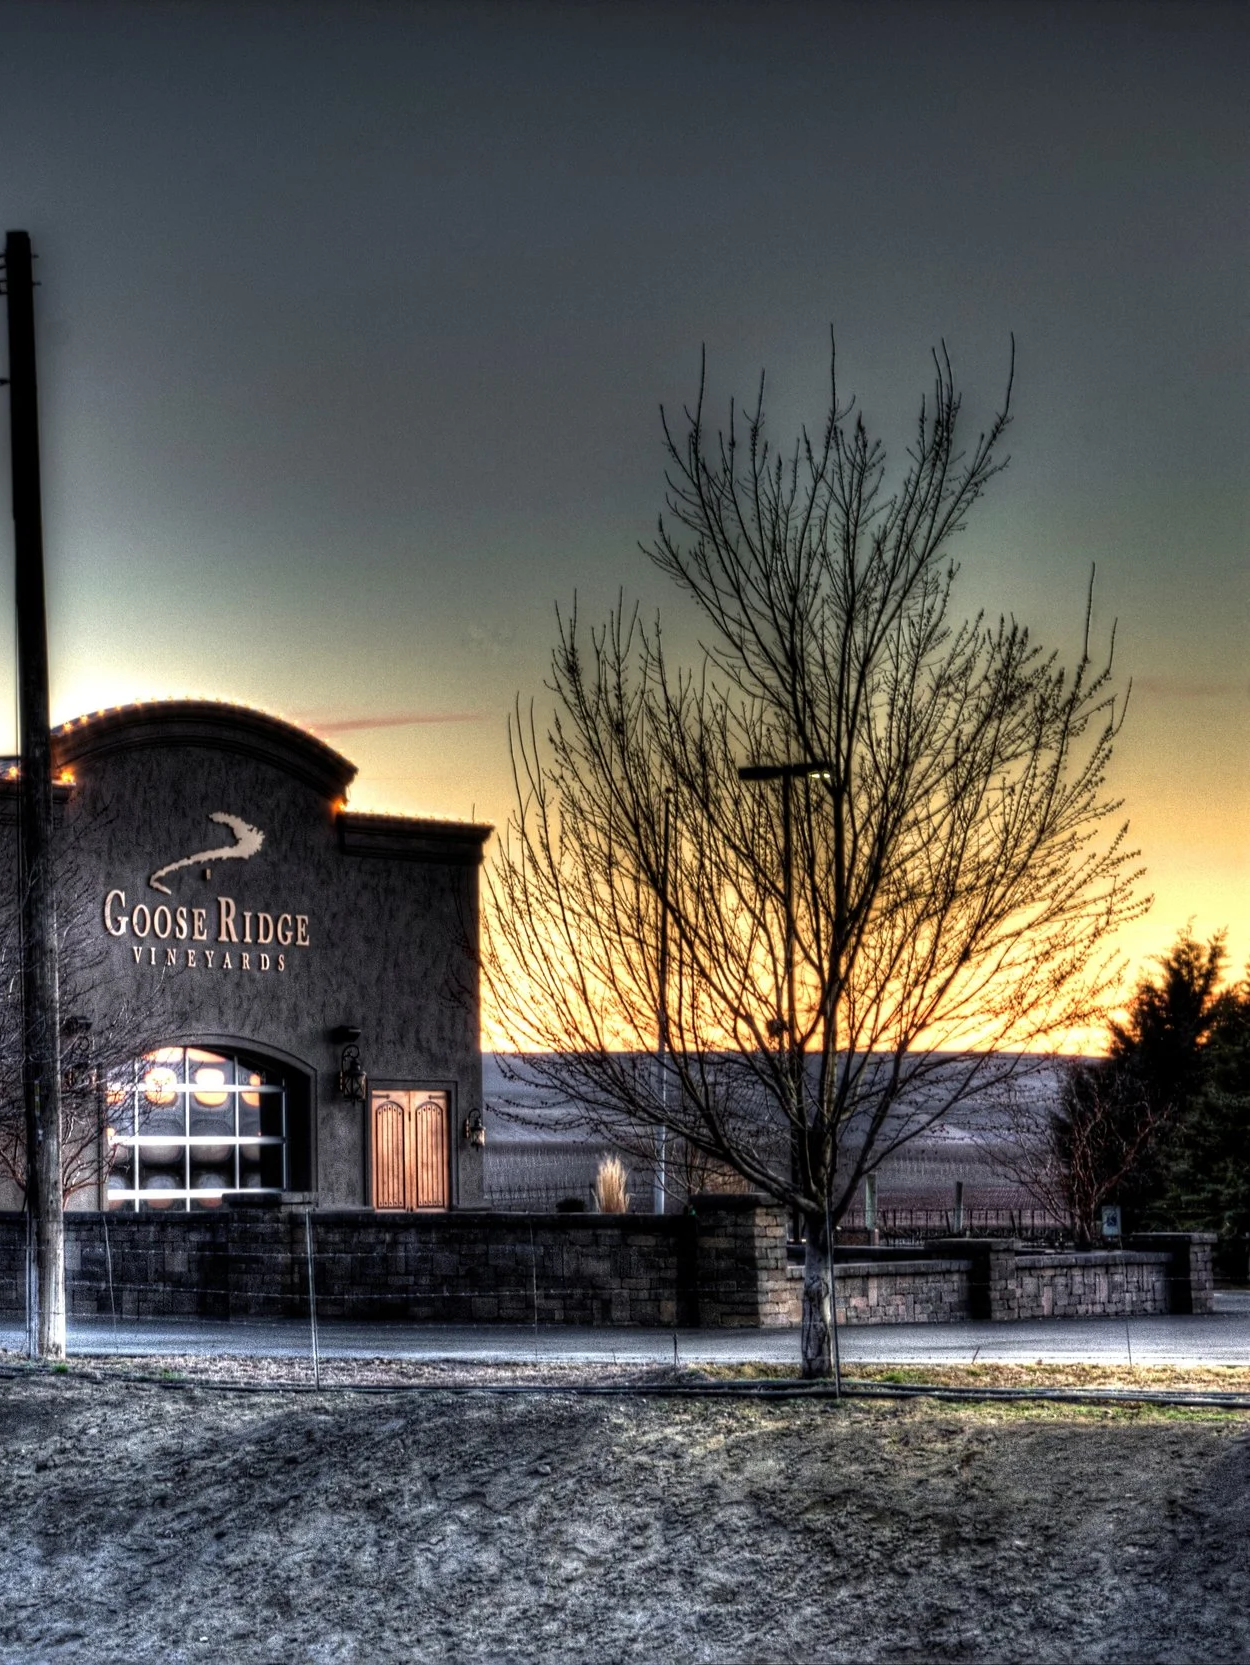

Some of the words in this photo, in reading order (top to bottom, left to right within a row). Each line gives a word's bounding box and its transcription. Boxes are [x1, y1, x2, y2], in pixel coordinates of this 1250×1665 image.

[104, 889, 208, 940] GOOSE
[217, 896, 311, 946] RIDGE
[132, 946, 286, 971] VINEYARDS
